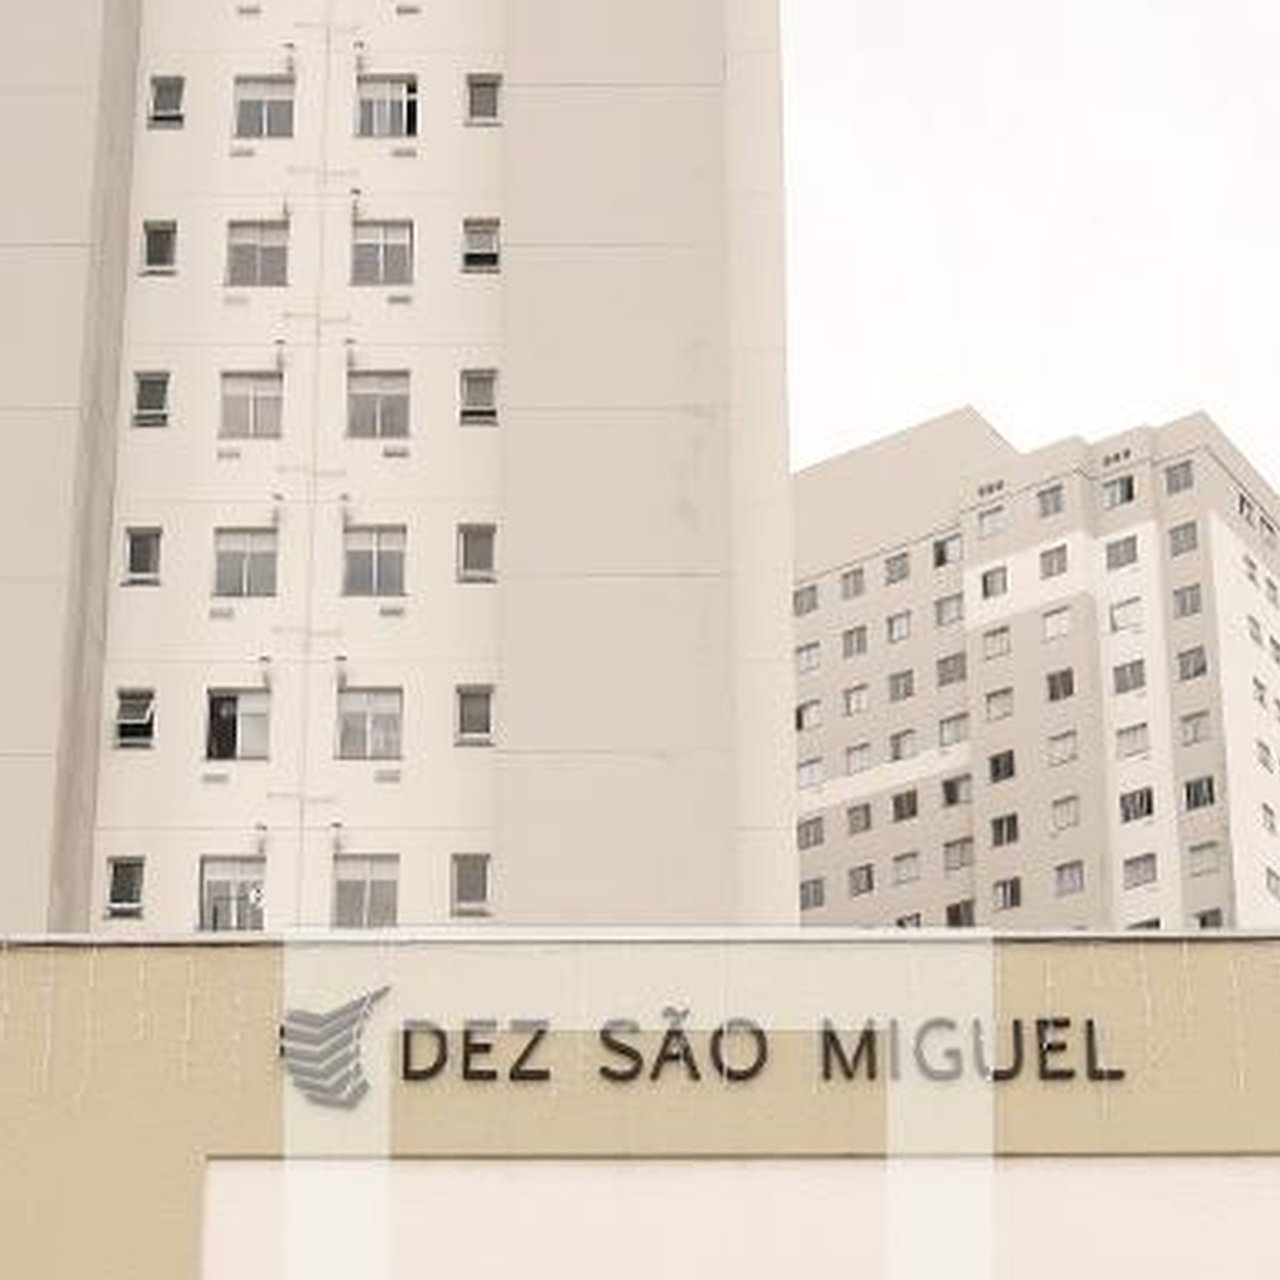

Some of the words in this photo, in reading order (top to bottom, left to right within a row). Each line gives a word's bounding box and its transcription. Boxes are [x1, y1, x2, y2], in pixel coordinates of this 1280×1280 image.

[402, 1018, 552, 1083] DEZ
[597, 1006, 769, 1084] SÃO
[821, 1017, 1126, 1083] MIGUEL
